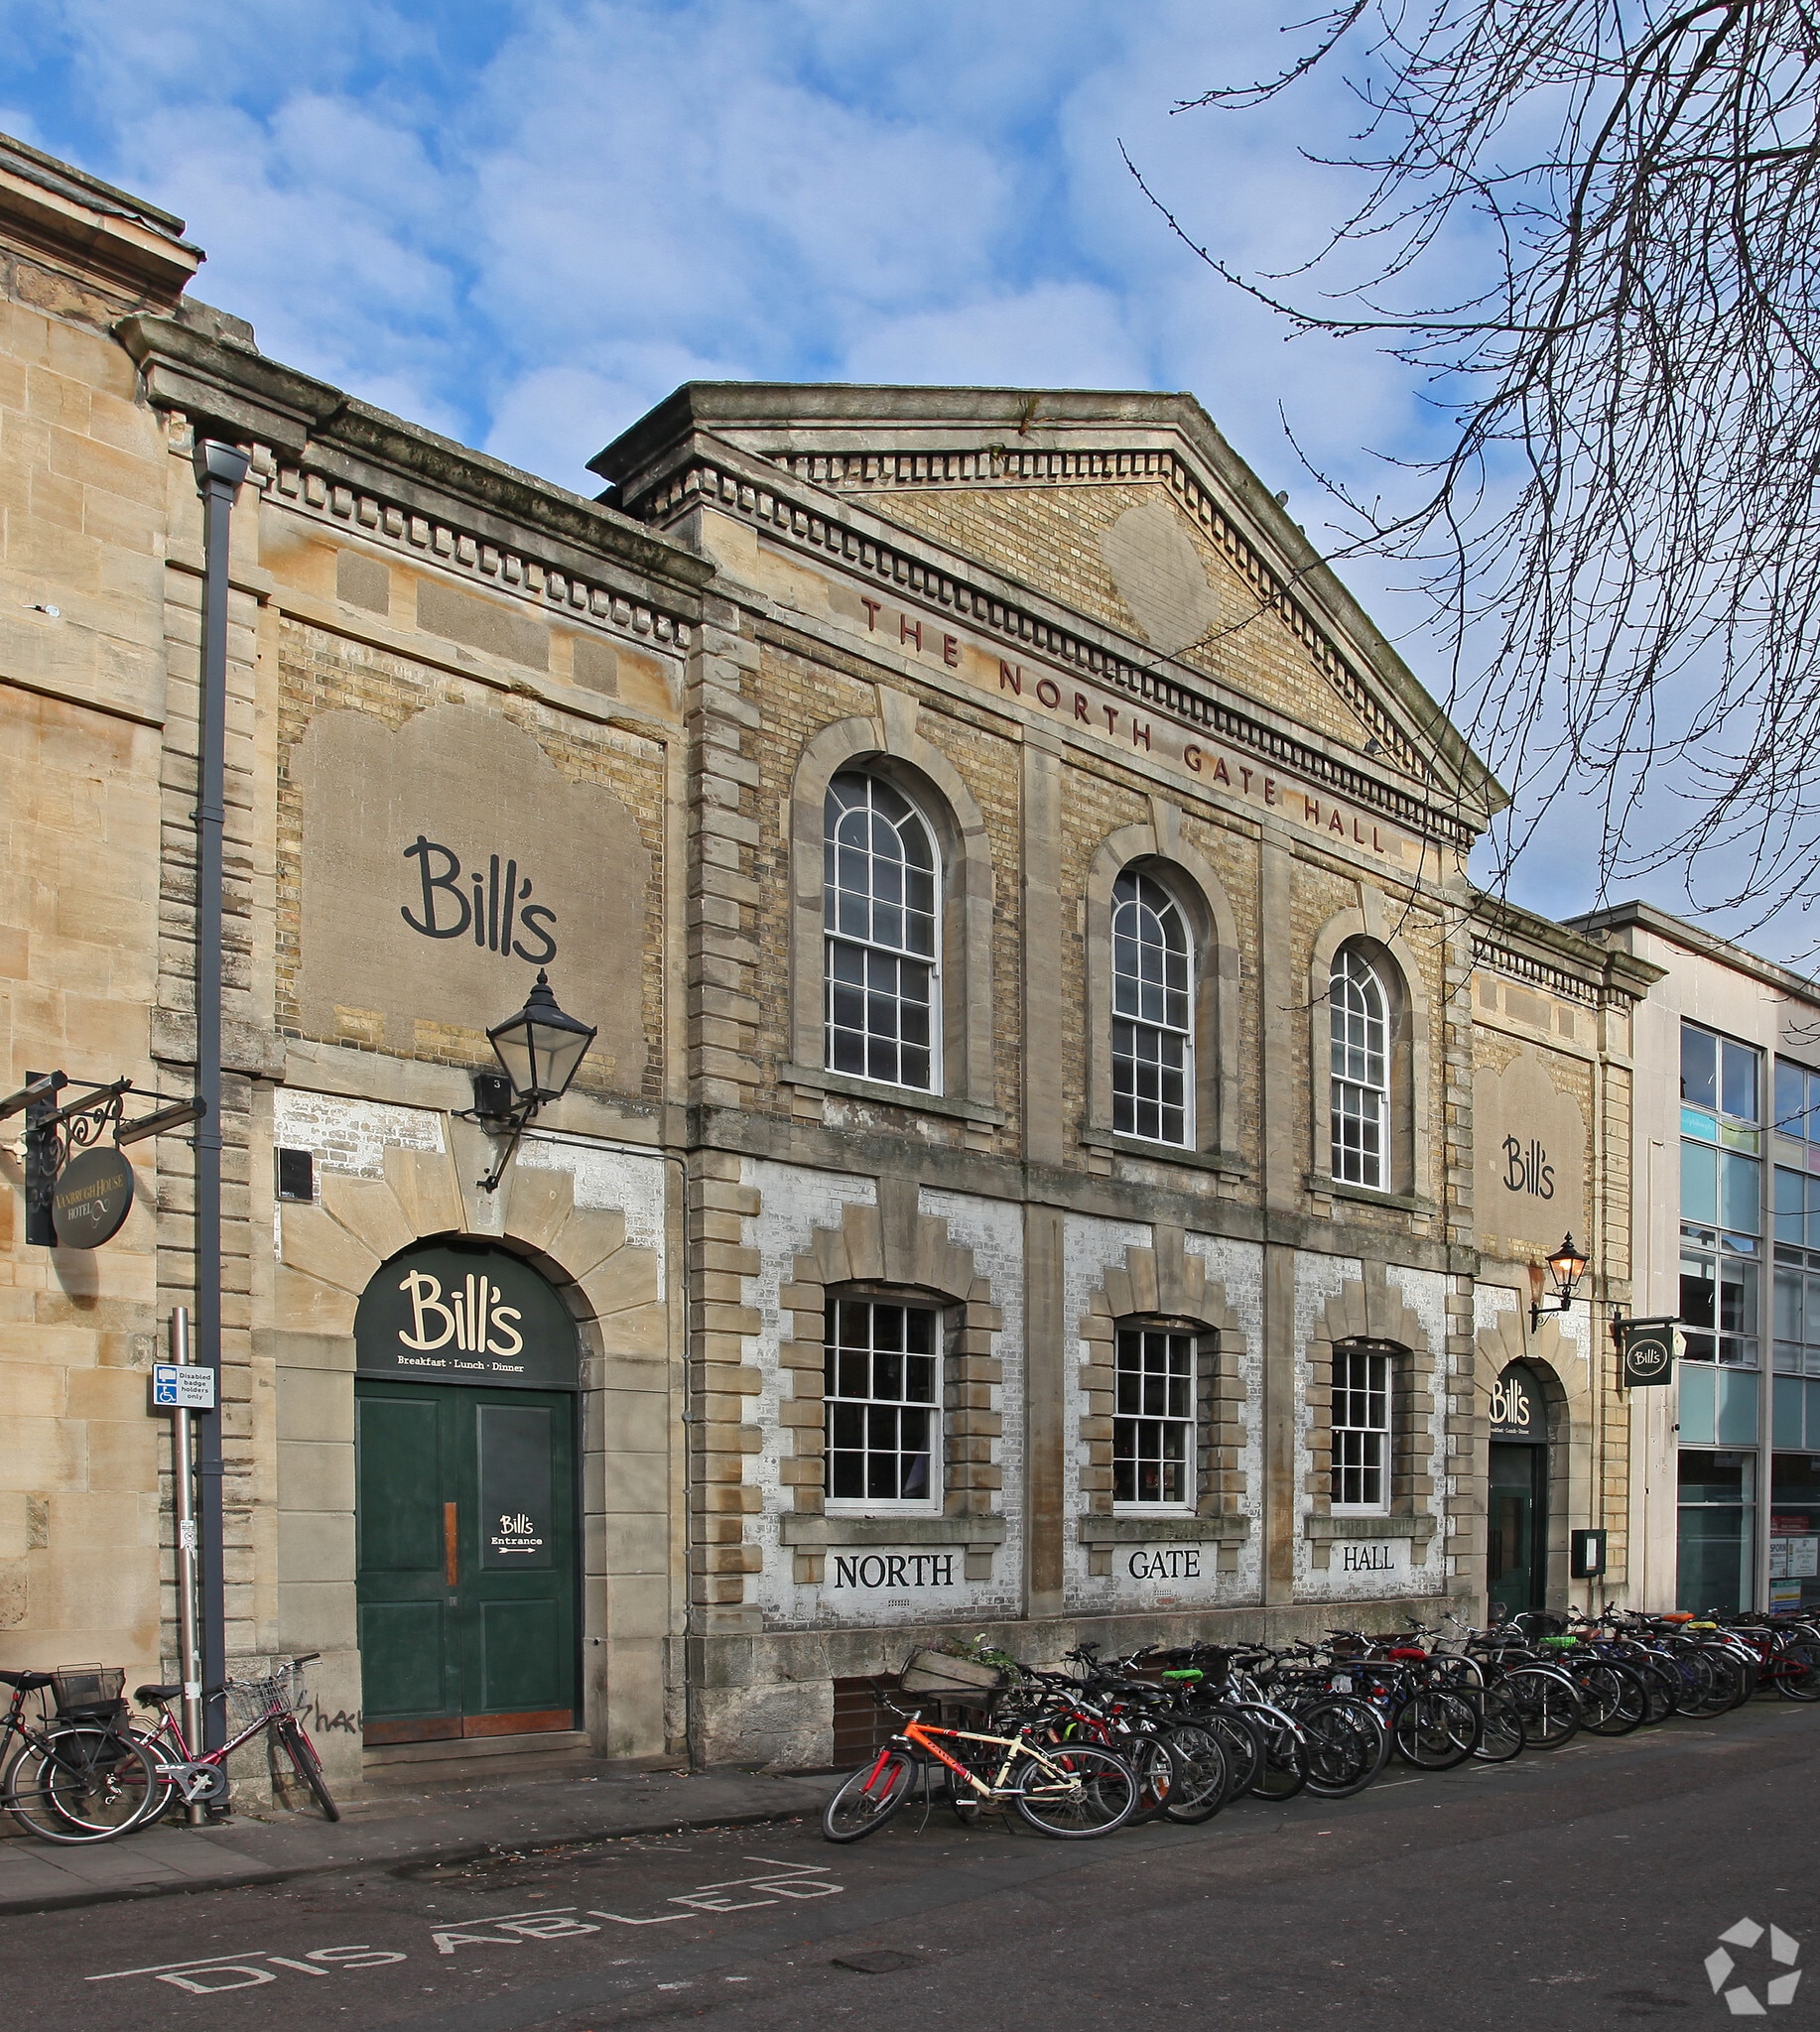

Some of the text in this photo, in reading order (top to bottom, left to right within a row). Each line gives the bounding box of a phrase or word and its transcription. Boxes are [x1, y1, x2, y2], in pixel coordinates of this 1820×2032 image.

[860, 596, 1384, 854] THE NORTH GATE HALL
[401, 835, 557, 964] Bill's
[493, 1080, 501, 1088] 3
[1501, 1133, 1555, 1201] Bill's
[67, 1203, 91, 1220] HOTEL
[399, 1269, 524, 1356] Bill's
[397, 1355, 525, 1373] Breakfast Lunch Dinner
[1633, 1348, 1661, 1366] Bill's
[1489, 1376, 1530, 1426] Bill's
[499, 1513, 534, 1535] Bill's
[834, 1545, 1395, 1588] NORTH GATE HALL
[154, 1880, 844, 1994] DISABLED
